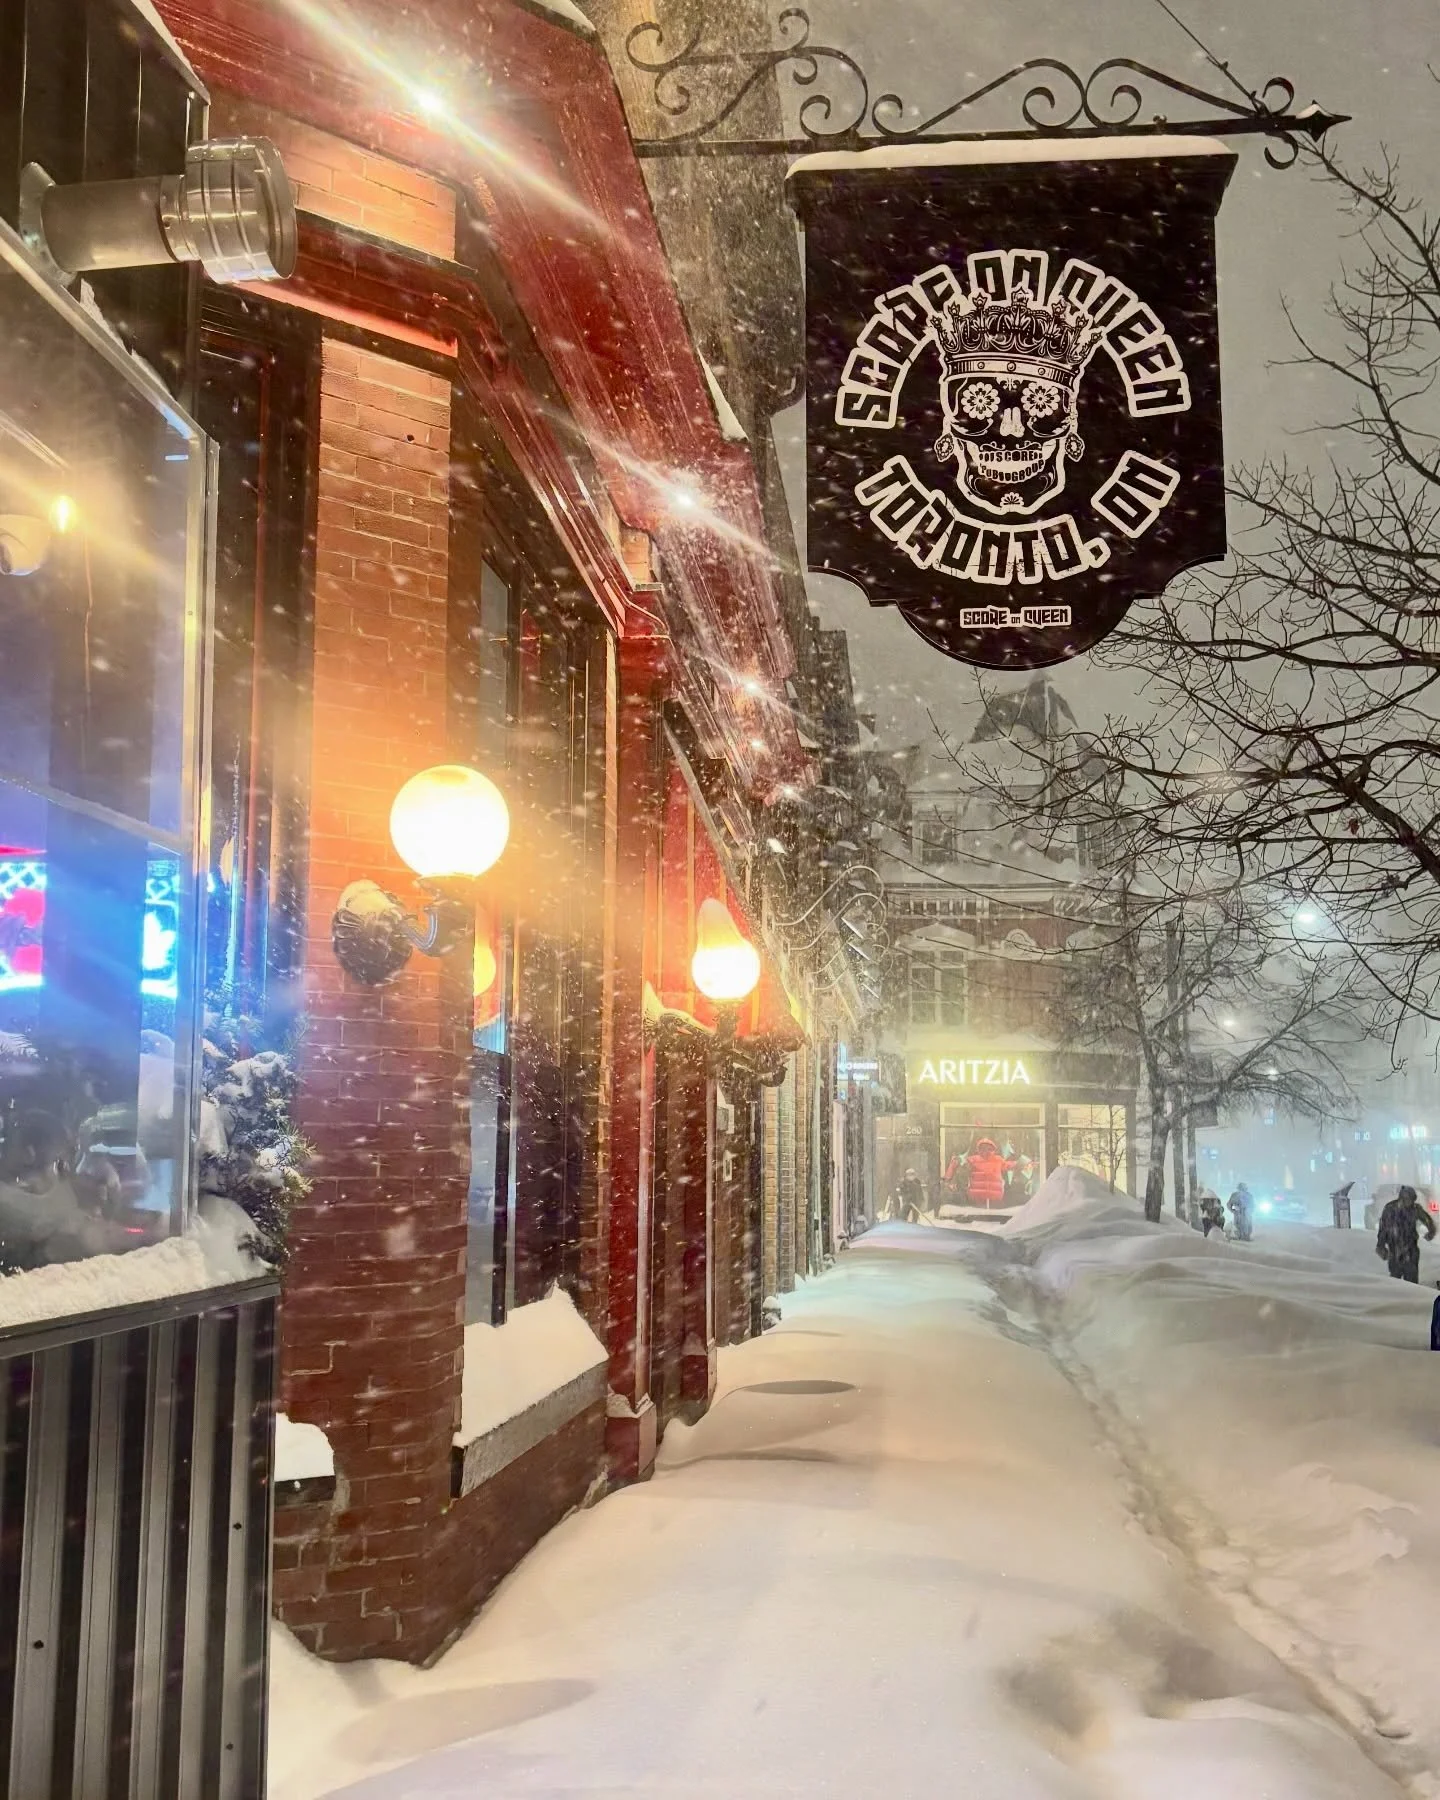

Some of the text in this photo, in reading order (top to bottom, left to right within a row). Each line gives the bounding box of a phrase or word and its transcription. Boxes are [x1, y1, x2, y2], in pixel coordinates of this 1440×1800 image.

[839, 252, 1188, 425] SCORE ON QUEEN
[1095, 453, 1177, 534] ON
[962, 608, 1008, 626] SCORE
[1023, 608, 1069, 626] QUEEN
[918, 1058, 1031, 1086] ARITZIA
